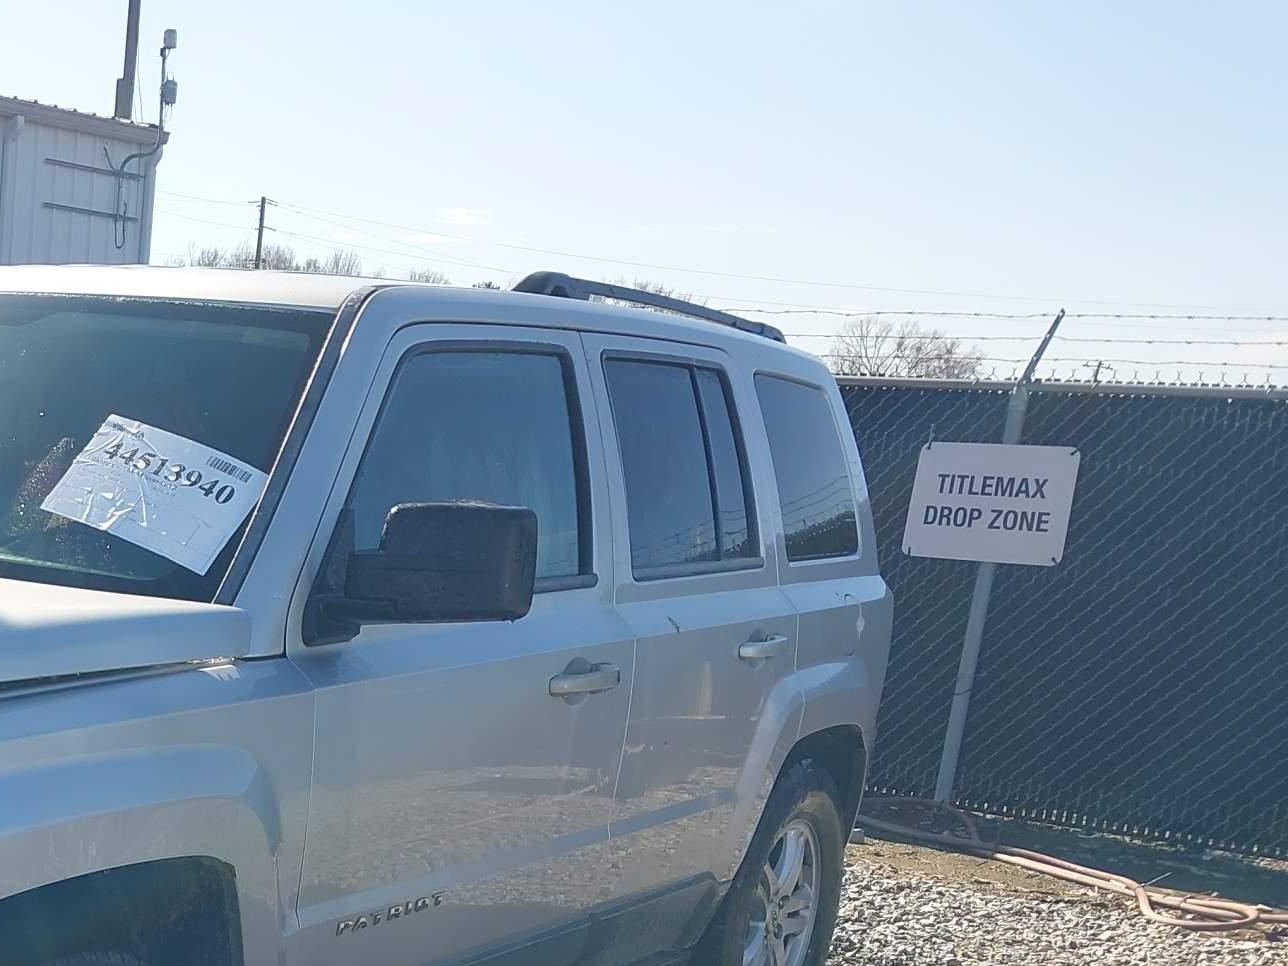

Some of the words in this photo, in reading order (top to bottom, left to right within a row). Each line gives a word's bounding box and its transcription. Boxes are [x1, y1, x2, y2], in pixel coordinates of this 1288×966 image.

[103, 442, 235, 505] 44513940
[938, 473, 1049, 499] TITLEMAX
[923, 505, 982, 528] DROP
[987, 509, 1051, 532] ZONE
[336, 890, 447, 936] PATRIOT
